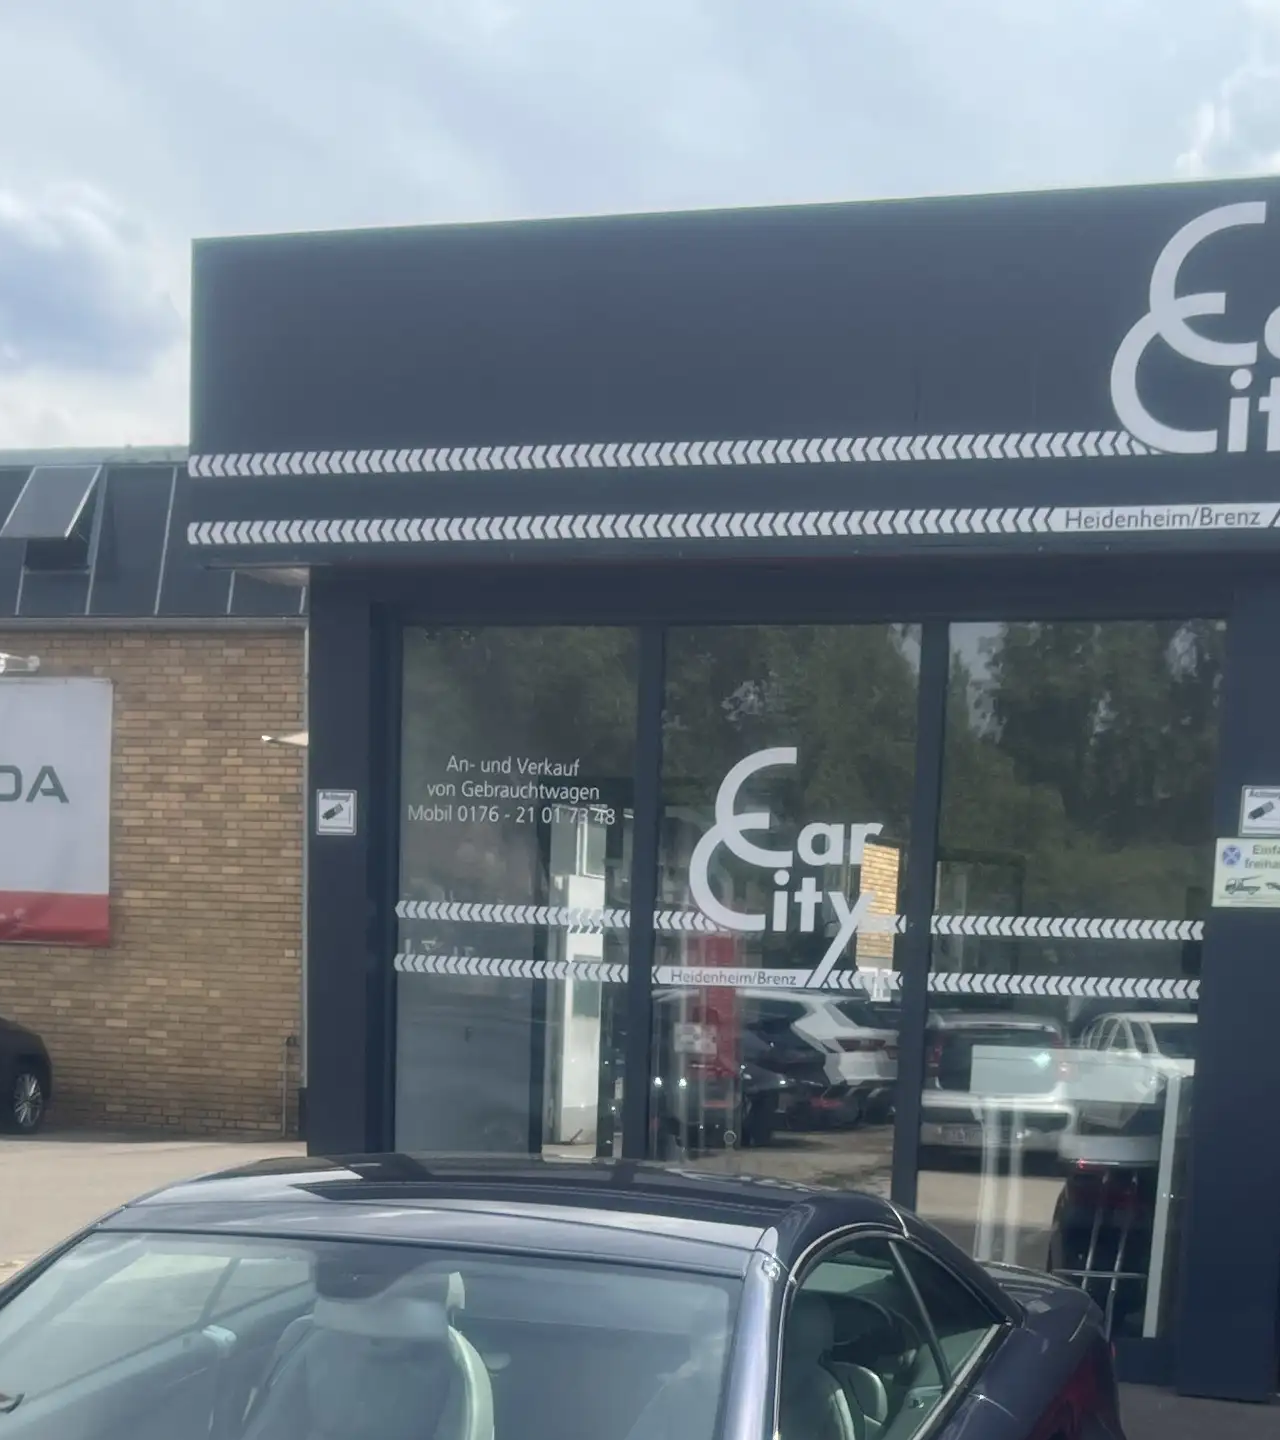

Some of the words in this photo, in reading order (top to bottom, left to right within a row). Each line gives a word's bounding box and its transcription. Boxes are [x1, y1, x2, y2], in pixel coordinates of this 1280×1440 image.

[1064, 507, 1261, 530] Heidenheim/Brenz
[446, 755, 475, 773] An-
[481, 756, 511, 773] und
[516, 757, 580, 777] Verkauf
[427, 782, 455, 798] von
[461, 780, 600, 804] Gebrauchtwagen
[407, 804, 452, 822] Mobil
[457, 805, 499, 823] 0176
[516, 806, 535, 823] 21
[542, 806, 561, 824] 01
[594, 808, 616, 825] 48
[715, 746, 884, 868] Car
[689, 812, 877, 988] City
[670, 970, 797, 987] Heidenheim/Brenz
